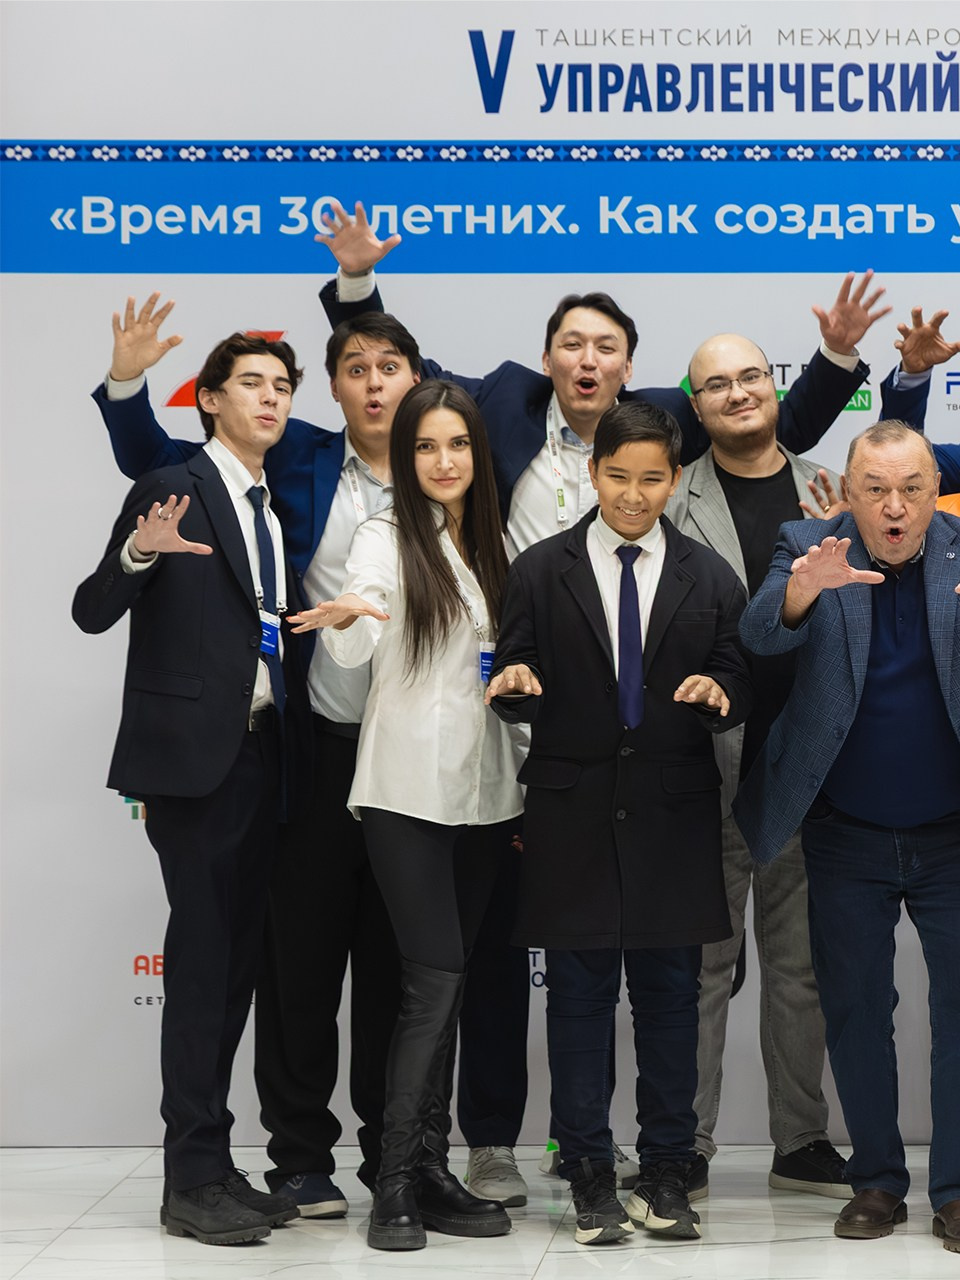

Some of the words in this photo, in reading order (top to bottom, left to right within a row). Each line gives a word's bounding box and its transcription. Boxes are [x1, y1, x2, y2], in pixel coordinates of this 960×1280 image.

[536, 24, 752, 47] ТАШКЕНТСКИЙ
[469, 30, 515, 113] V
[537, 51, 960, 113] УПРАВЛЕНЧЕСКИЙ
[51, 196, 261, 244] «Время
[600, 196, 698, 234] Как
[715, 203, 935, 240] создать
